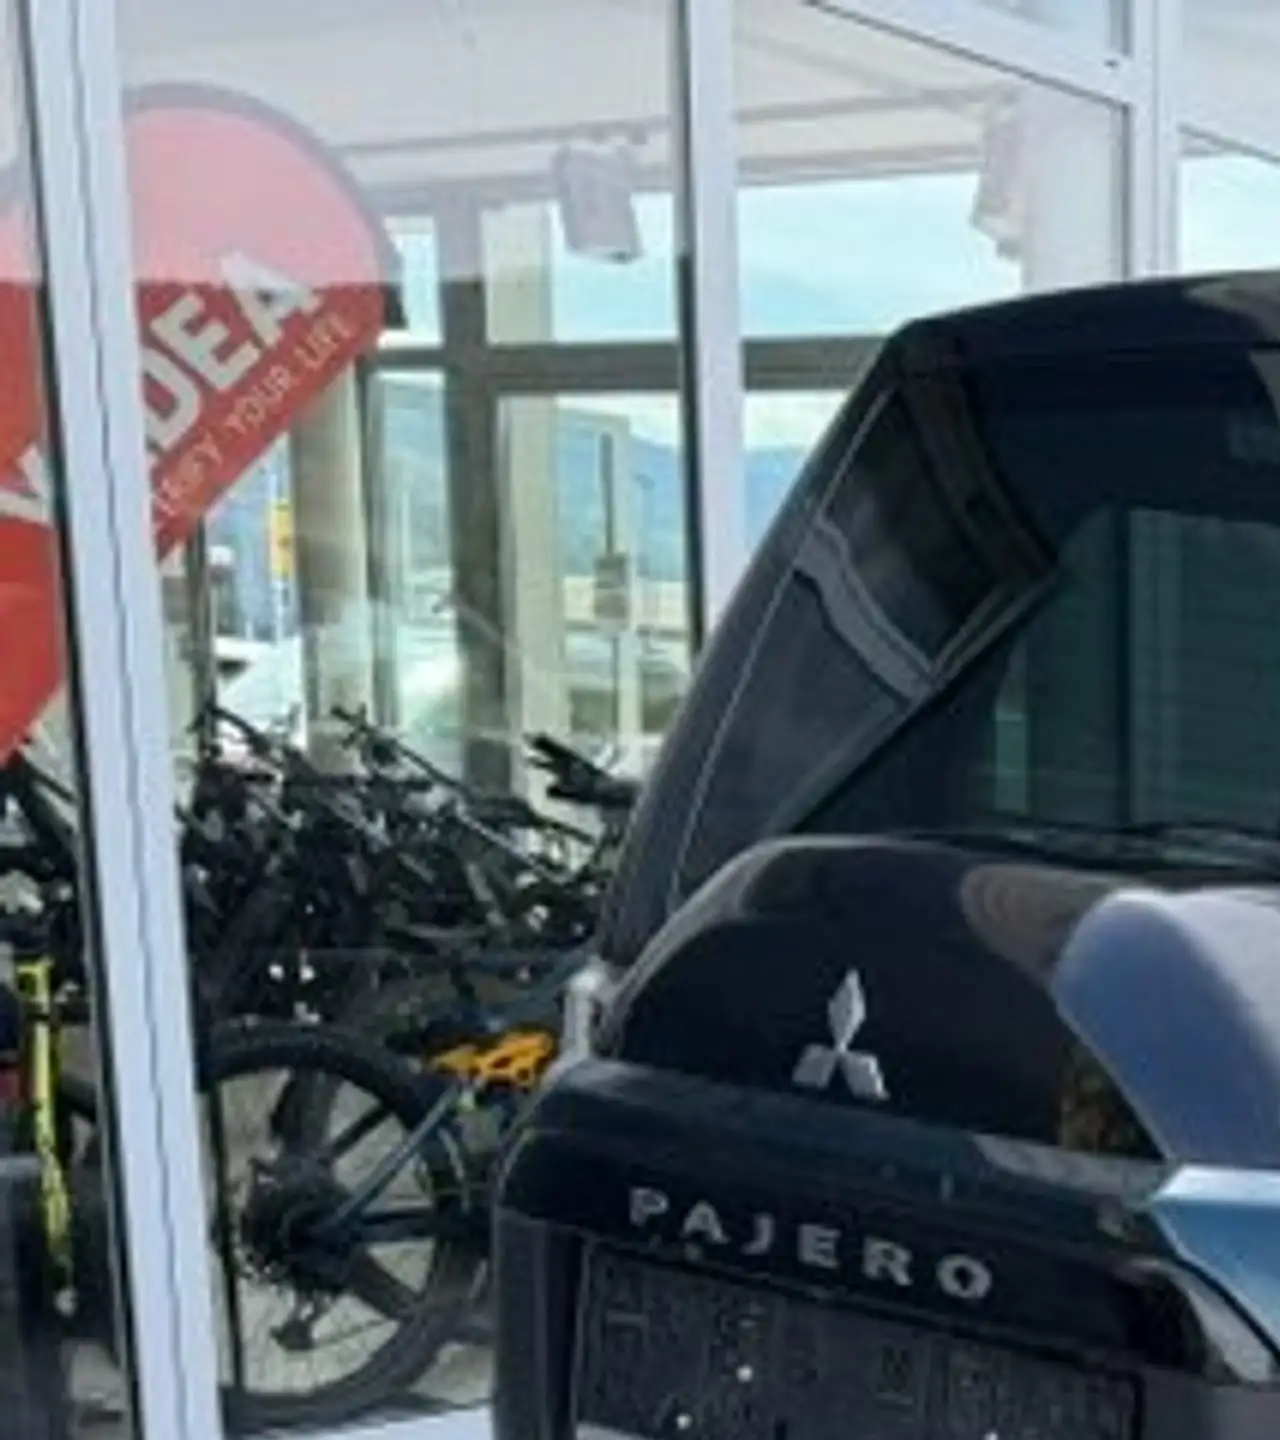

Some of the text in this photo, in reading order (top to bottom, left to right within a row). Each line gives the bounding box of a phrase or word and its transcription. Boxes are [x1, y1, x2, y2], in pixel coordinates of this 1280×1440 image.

[140, 250, 322, 450] DEA
[223, 363, 292, 436] YOUR
[628, 1186, 992, 1300] PAJERO
